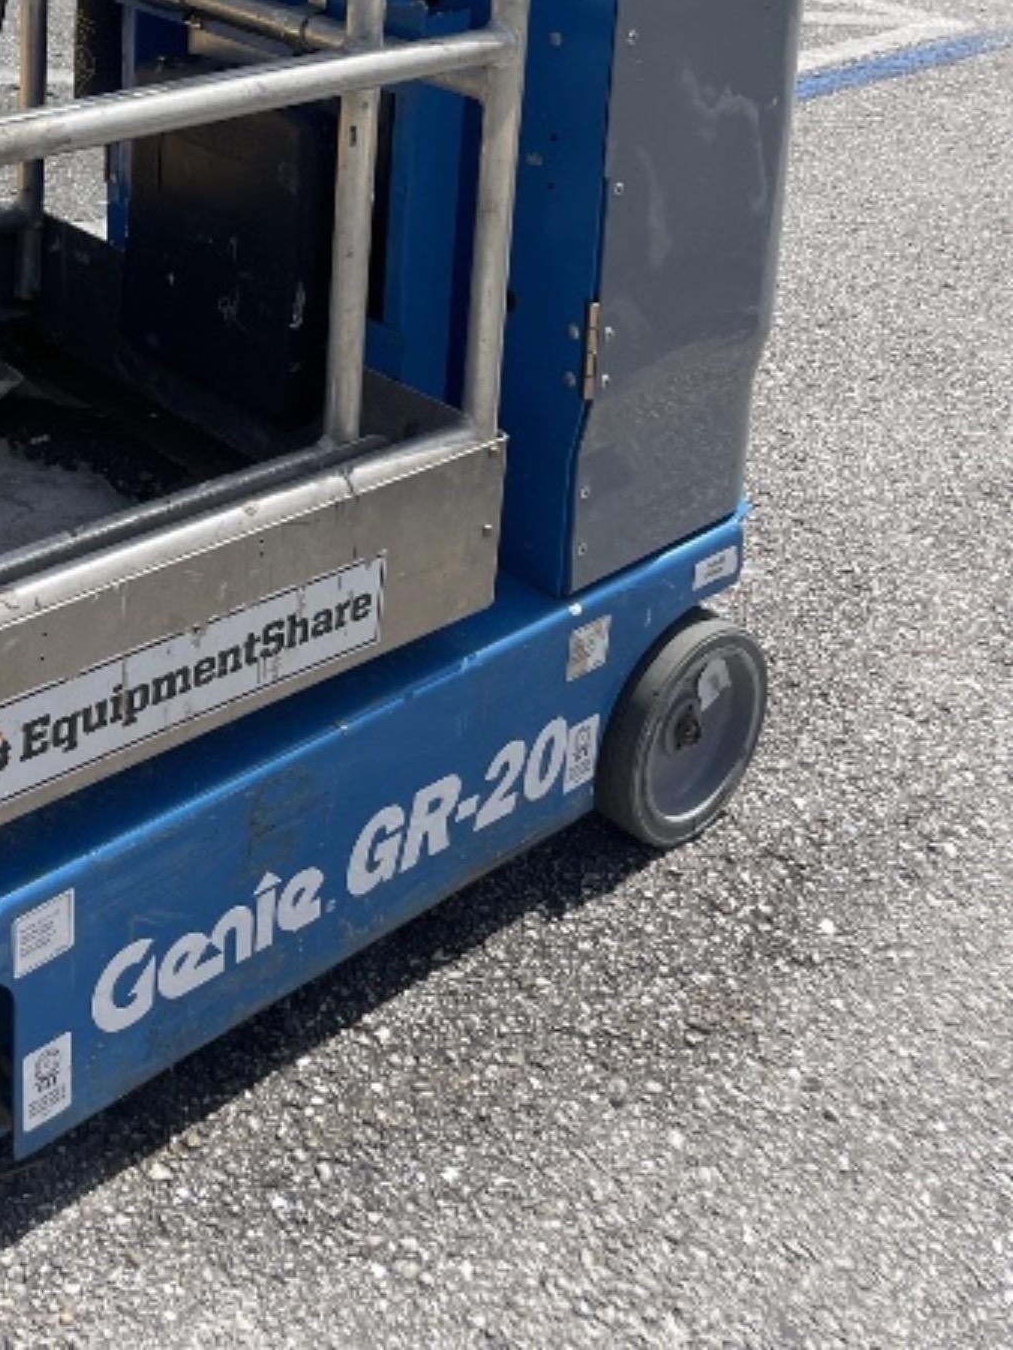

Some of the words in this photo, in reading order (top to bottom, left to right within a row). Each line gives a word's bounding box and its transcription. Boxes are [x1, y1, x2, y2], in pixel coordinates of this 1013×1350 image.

[19, 593, 373, 762] EquipmentShare
[92, 869, 324, 1032] Genie
[347, 714, 568, 895] GR-20
